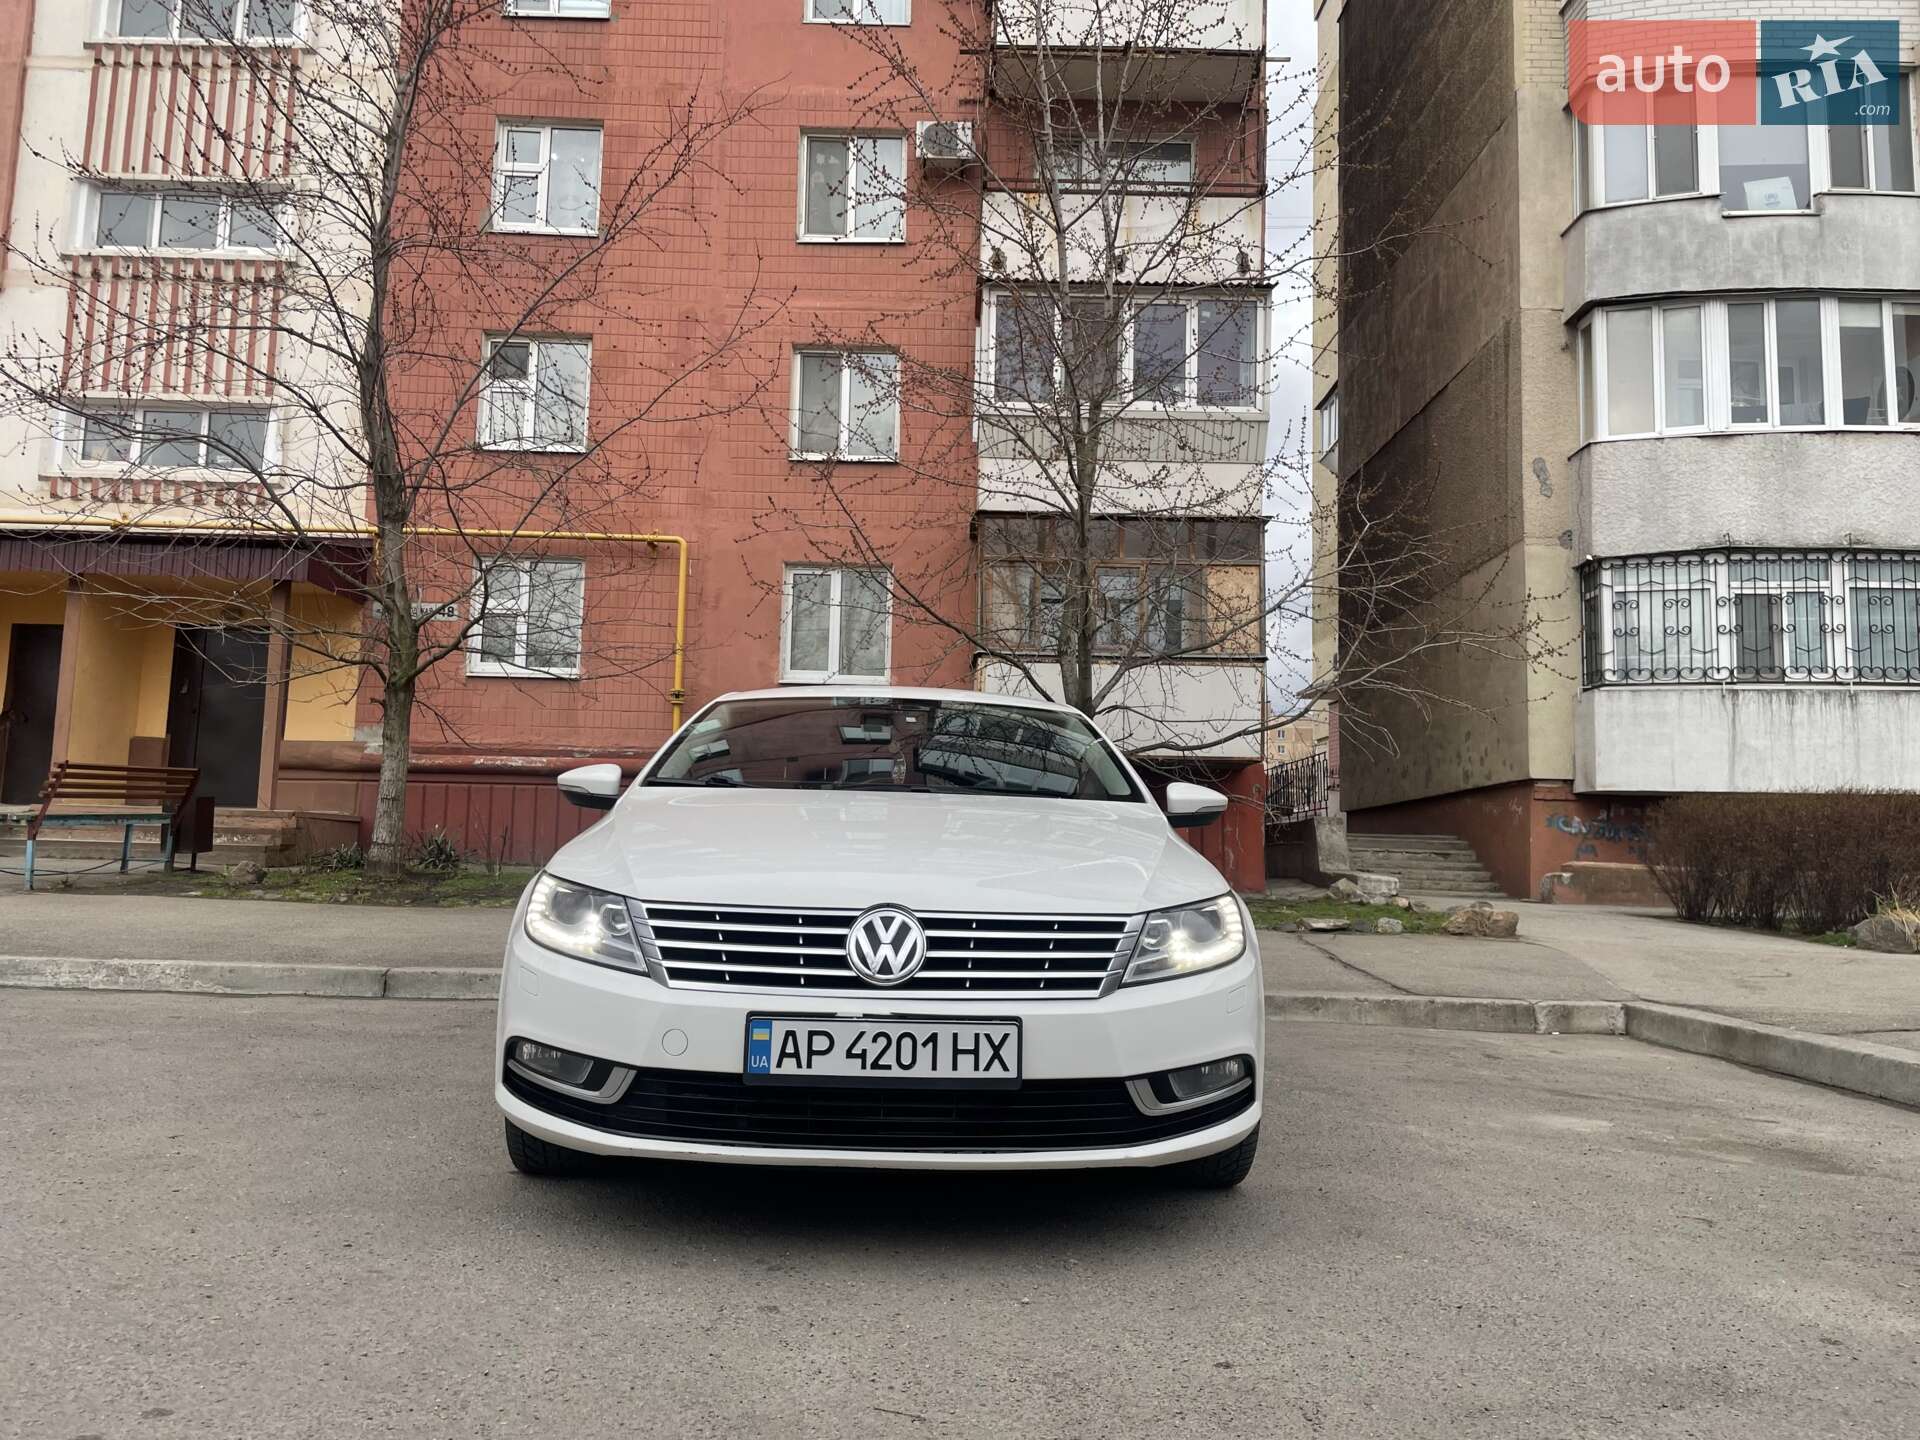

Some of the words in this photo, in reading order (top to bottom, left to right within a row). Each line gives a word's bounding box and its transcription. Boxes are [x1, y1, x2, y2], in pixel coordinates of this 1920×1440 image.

[751, 1055, 769, 1068] UA
[776, 1029, 836, 1070] AP
[845, 1031, 939, 1072] 4201
[951, 1032, 1011, 1073] HX
